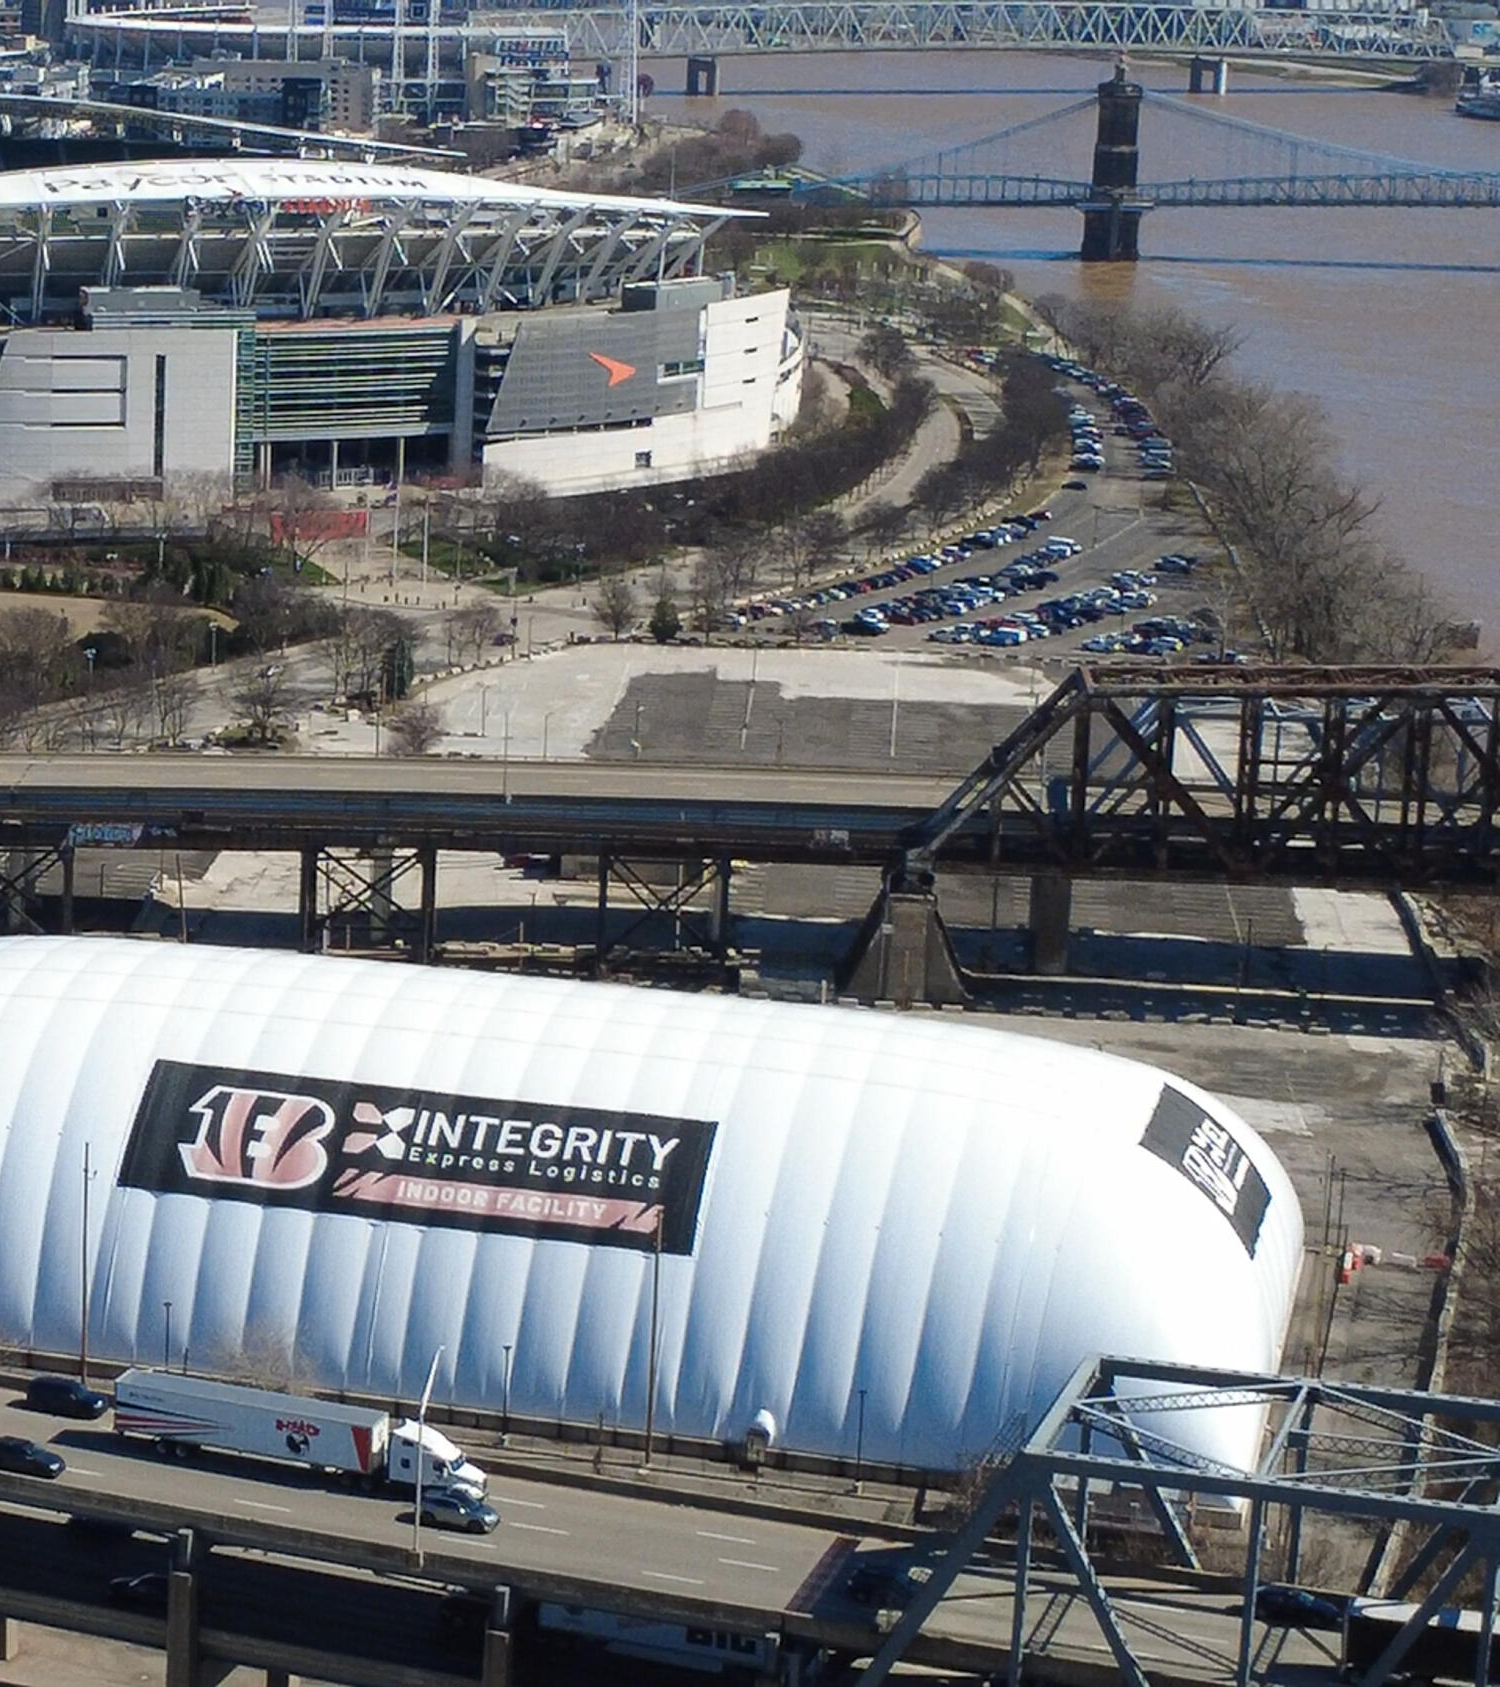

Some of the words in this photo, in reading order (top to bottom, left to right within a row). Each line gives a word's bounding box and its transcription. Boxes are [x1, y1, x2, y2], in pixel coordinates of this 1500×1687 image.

[260, 173, 428, 190] STADIUM
[412, 1109, 681, 1172] INTEGRITY
[408, 1146, 516, 1174] Express
[528, 1159, 661, 1190] Logistics
[396, 1180, 490, 1207] INDOOR
[496, 1189, 608, 1220] FACILITY
